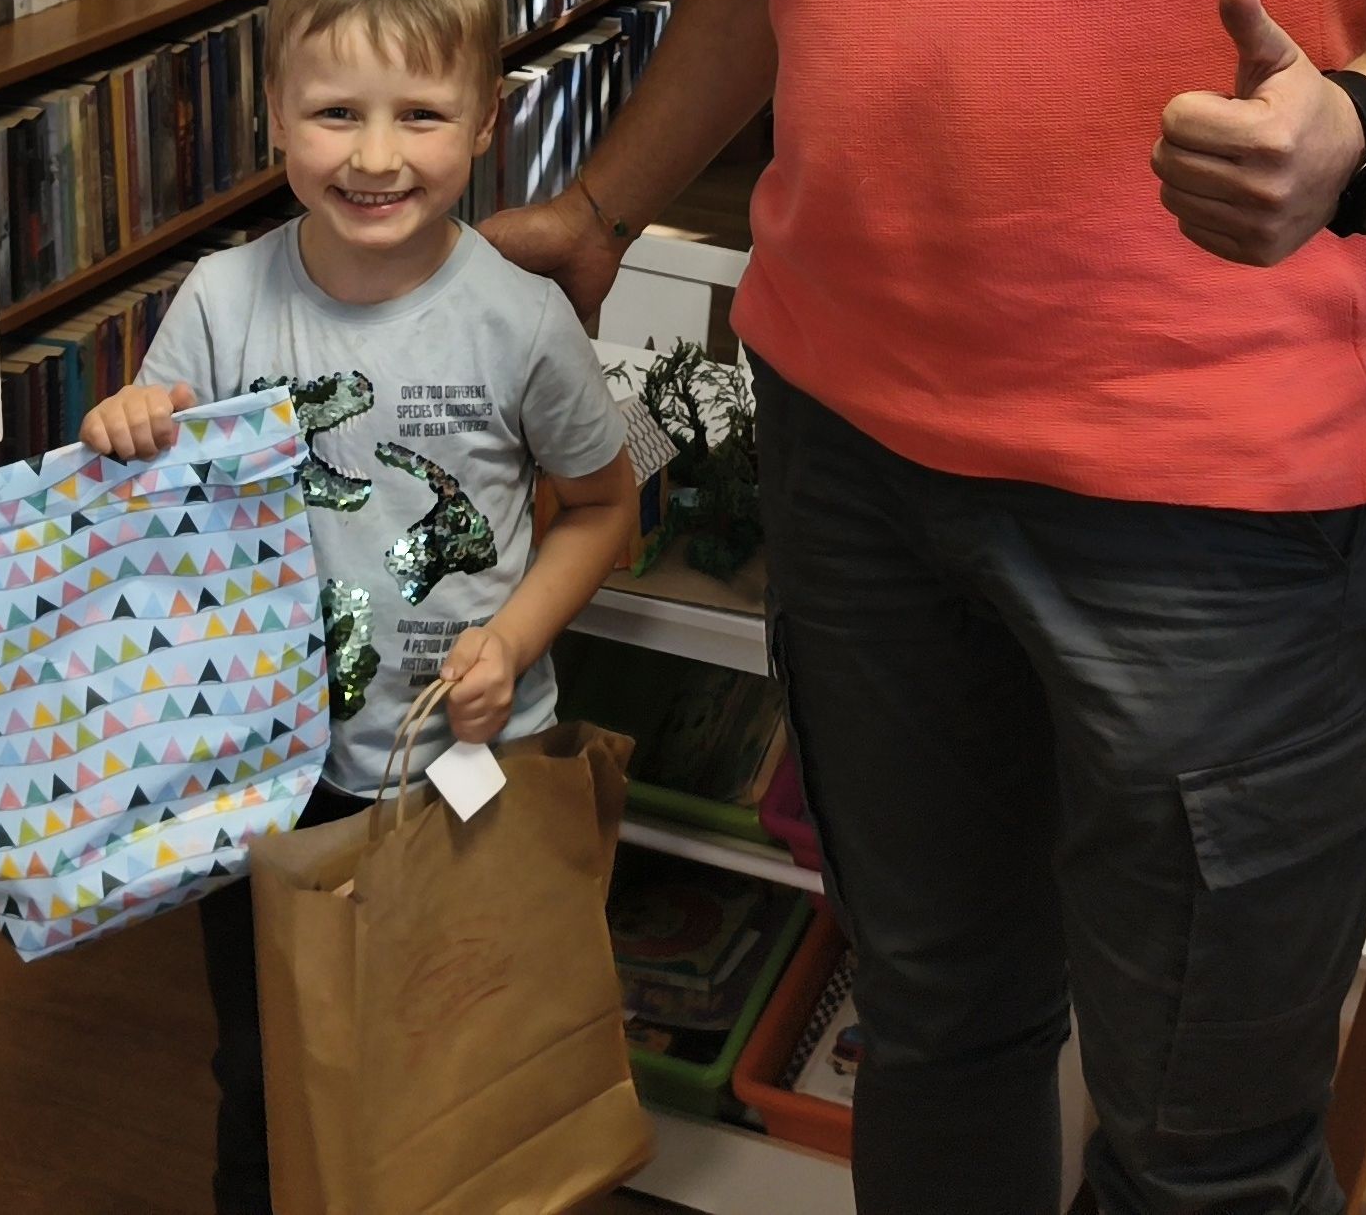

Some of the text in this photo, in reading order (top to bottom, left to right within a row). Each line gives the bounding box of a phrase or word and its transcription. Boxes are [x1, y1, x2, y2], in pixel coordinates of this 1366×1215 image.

[401, 385, 486, 399] OVER 700 DIFFERENT
[397, 403, 492, 418] SPECIES OF DINOSAURS
[399, 423, 421, 437] HAVE
[424, 422, 446, 437] BEEN
